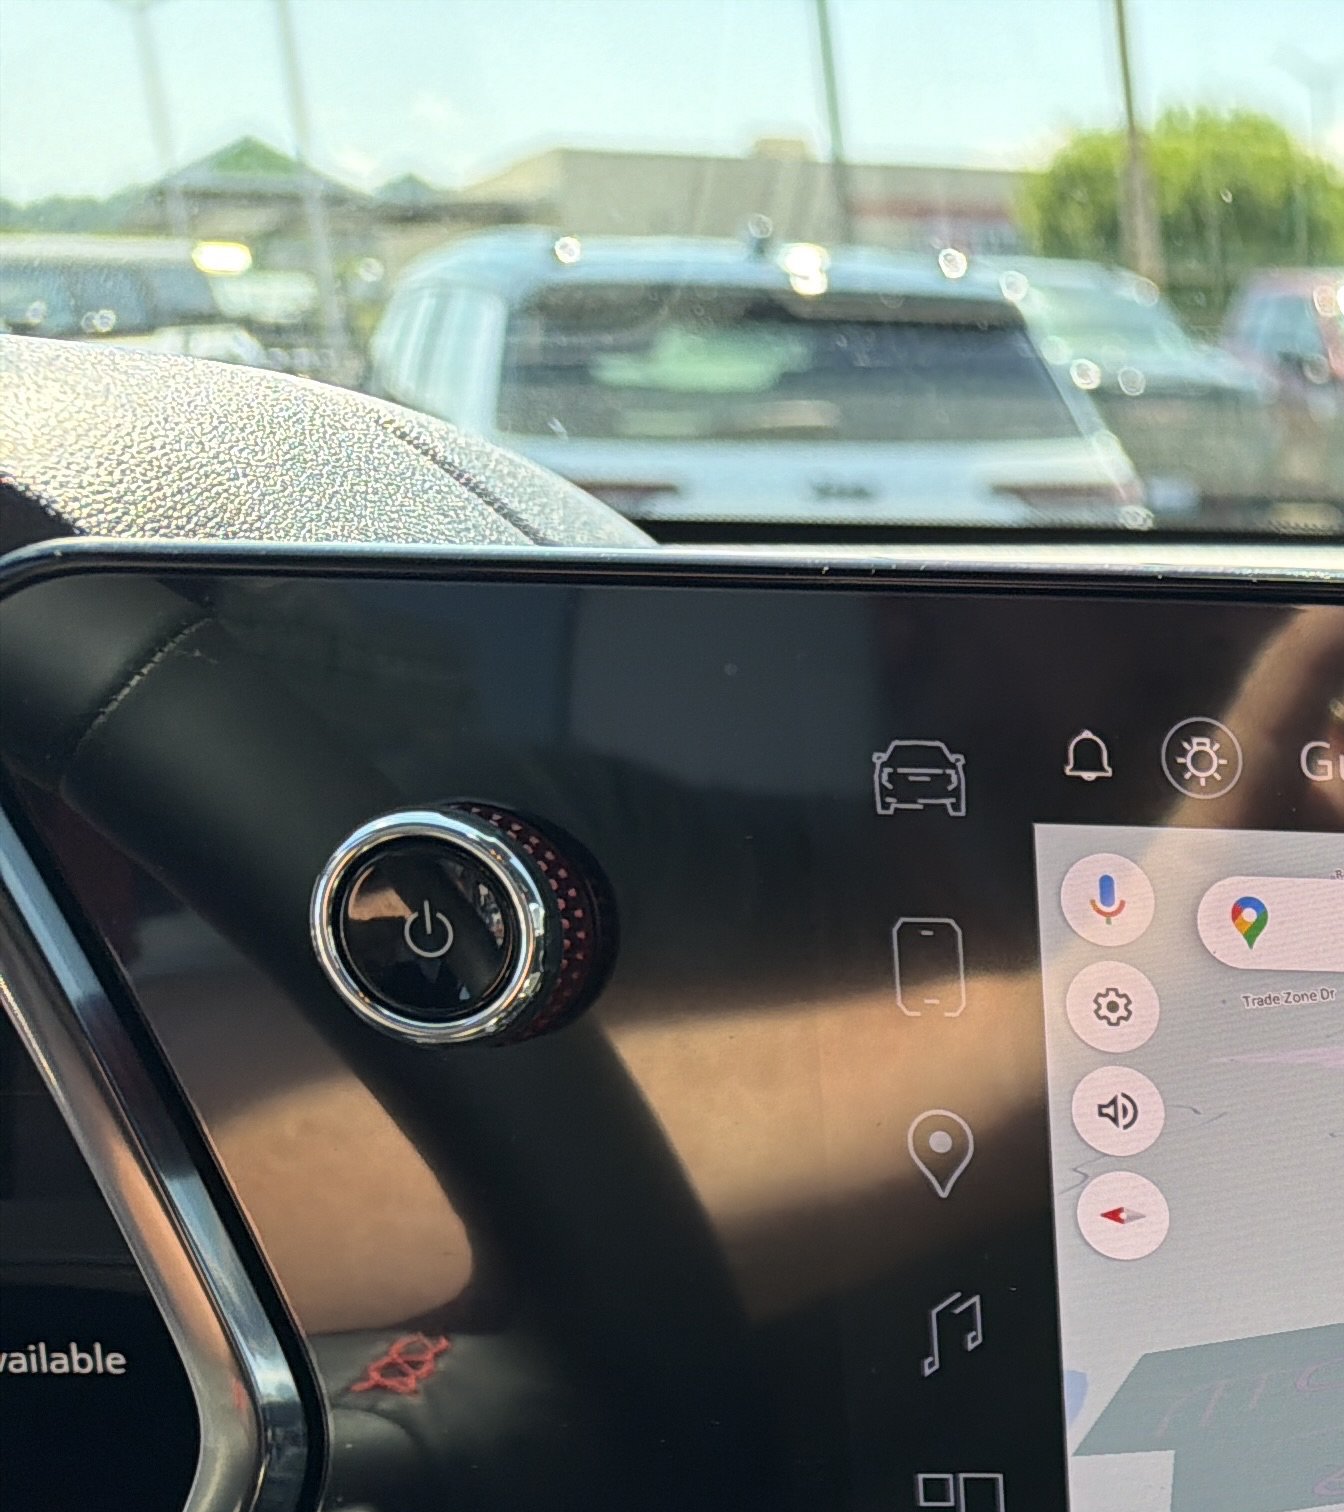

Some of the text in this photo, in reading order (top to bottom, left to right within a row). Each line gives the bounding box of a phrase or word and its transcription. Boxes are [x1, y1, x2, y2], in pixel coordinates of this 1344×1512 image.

[1242, 988, 1335, 1007] Trade Zone Dr
